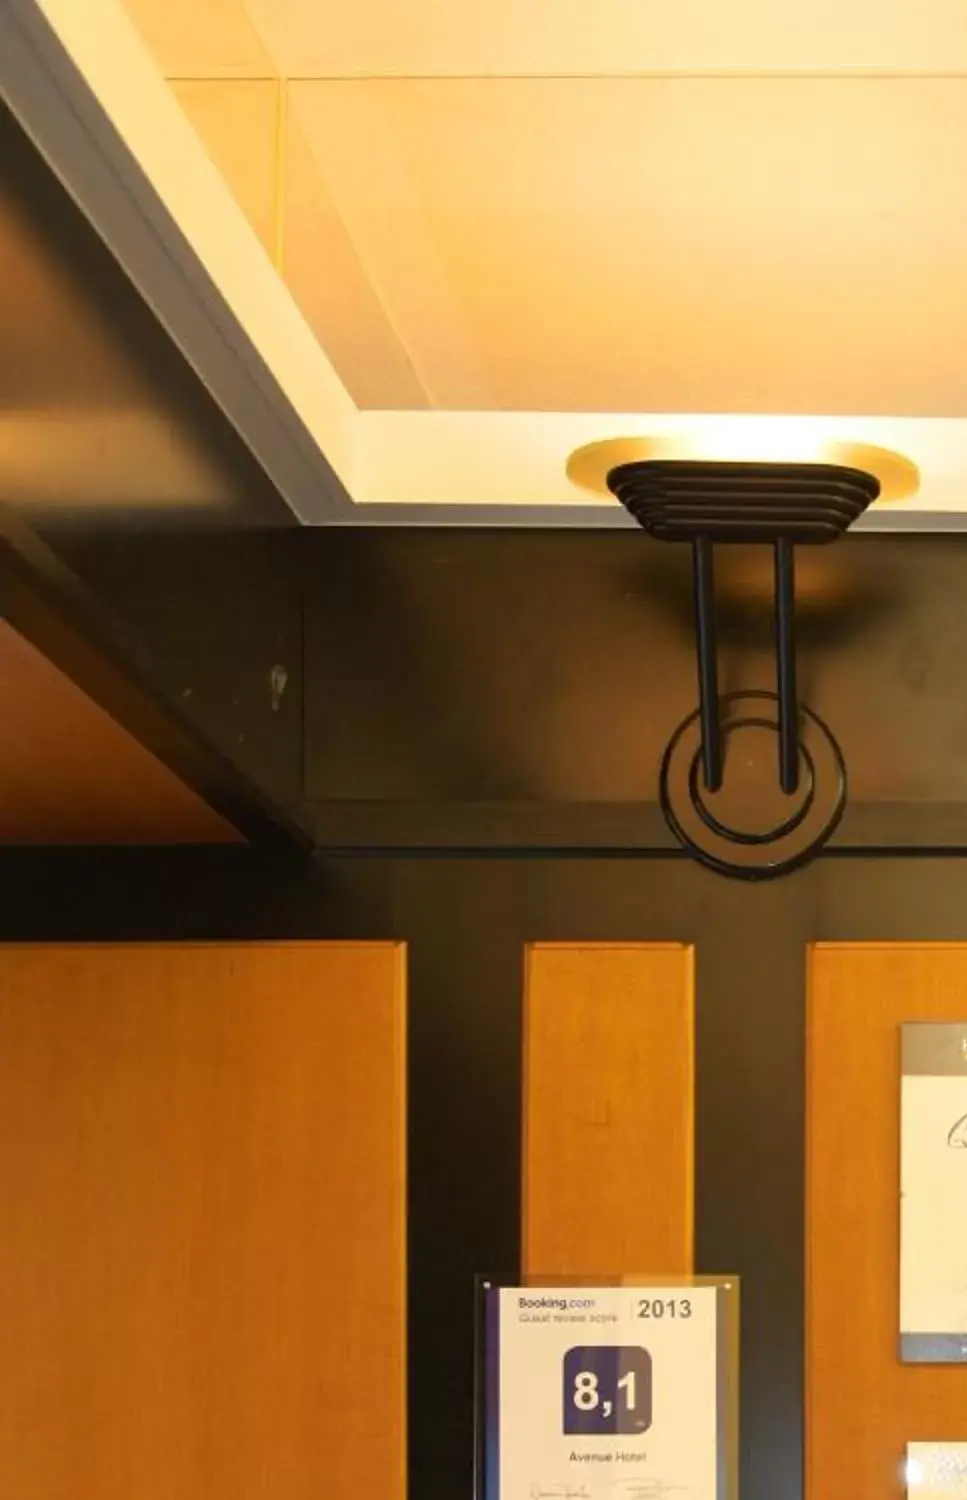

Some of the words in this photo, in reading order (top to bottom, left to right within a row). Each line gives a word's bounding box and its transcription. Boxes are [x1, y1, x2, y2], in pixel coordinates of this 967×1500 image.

[518, 1297, 597, 1310] Booking.com
[637, 1299, 693, 1319] 2013
[573, 1371, 637, 1418] 8,1
[569, 1451, 613, 1463] Avenue
[615, 1450, 647, 1463] Hotel
